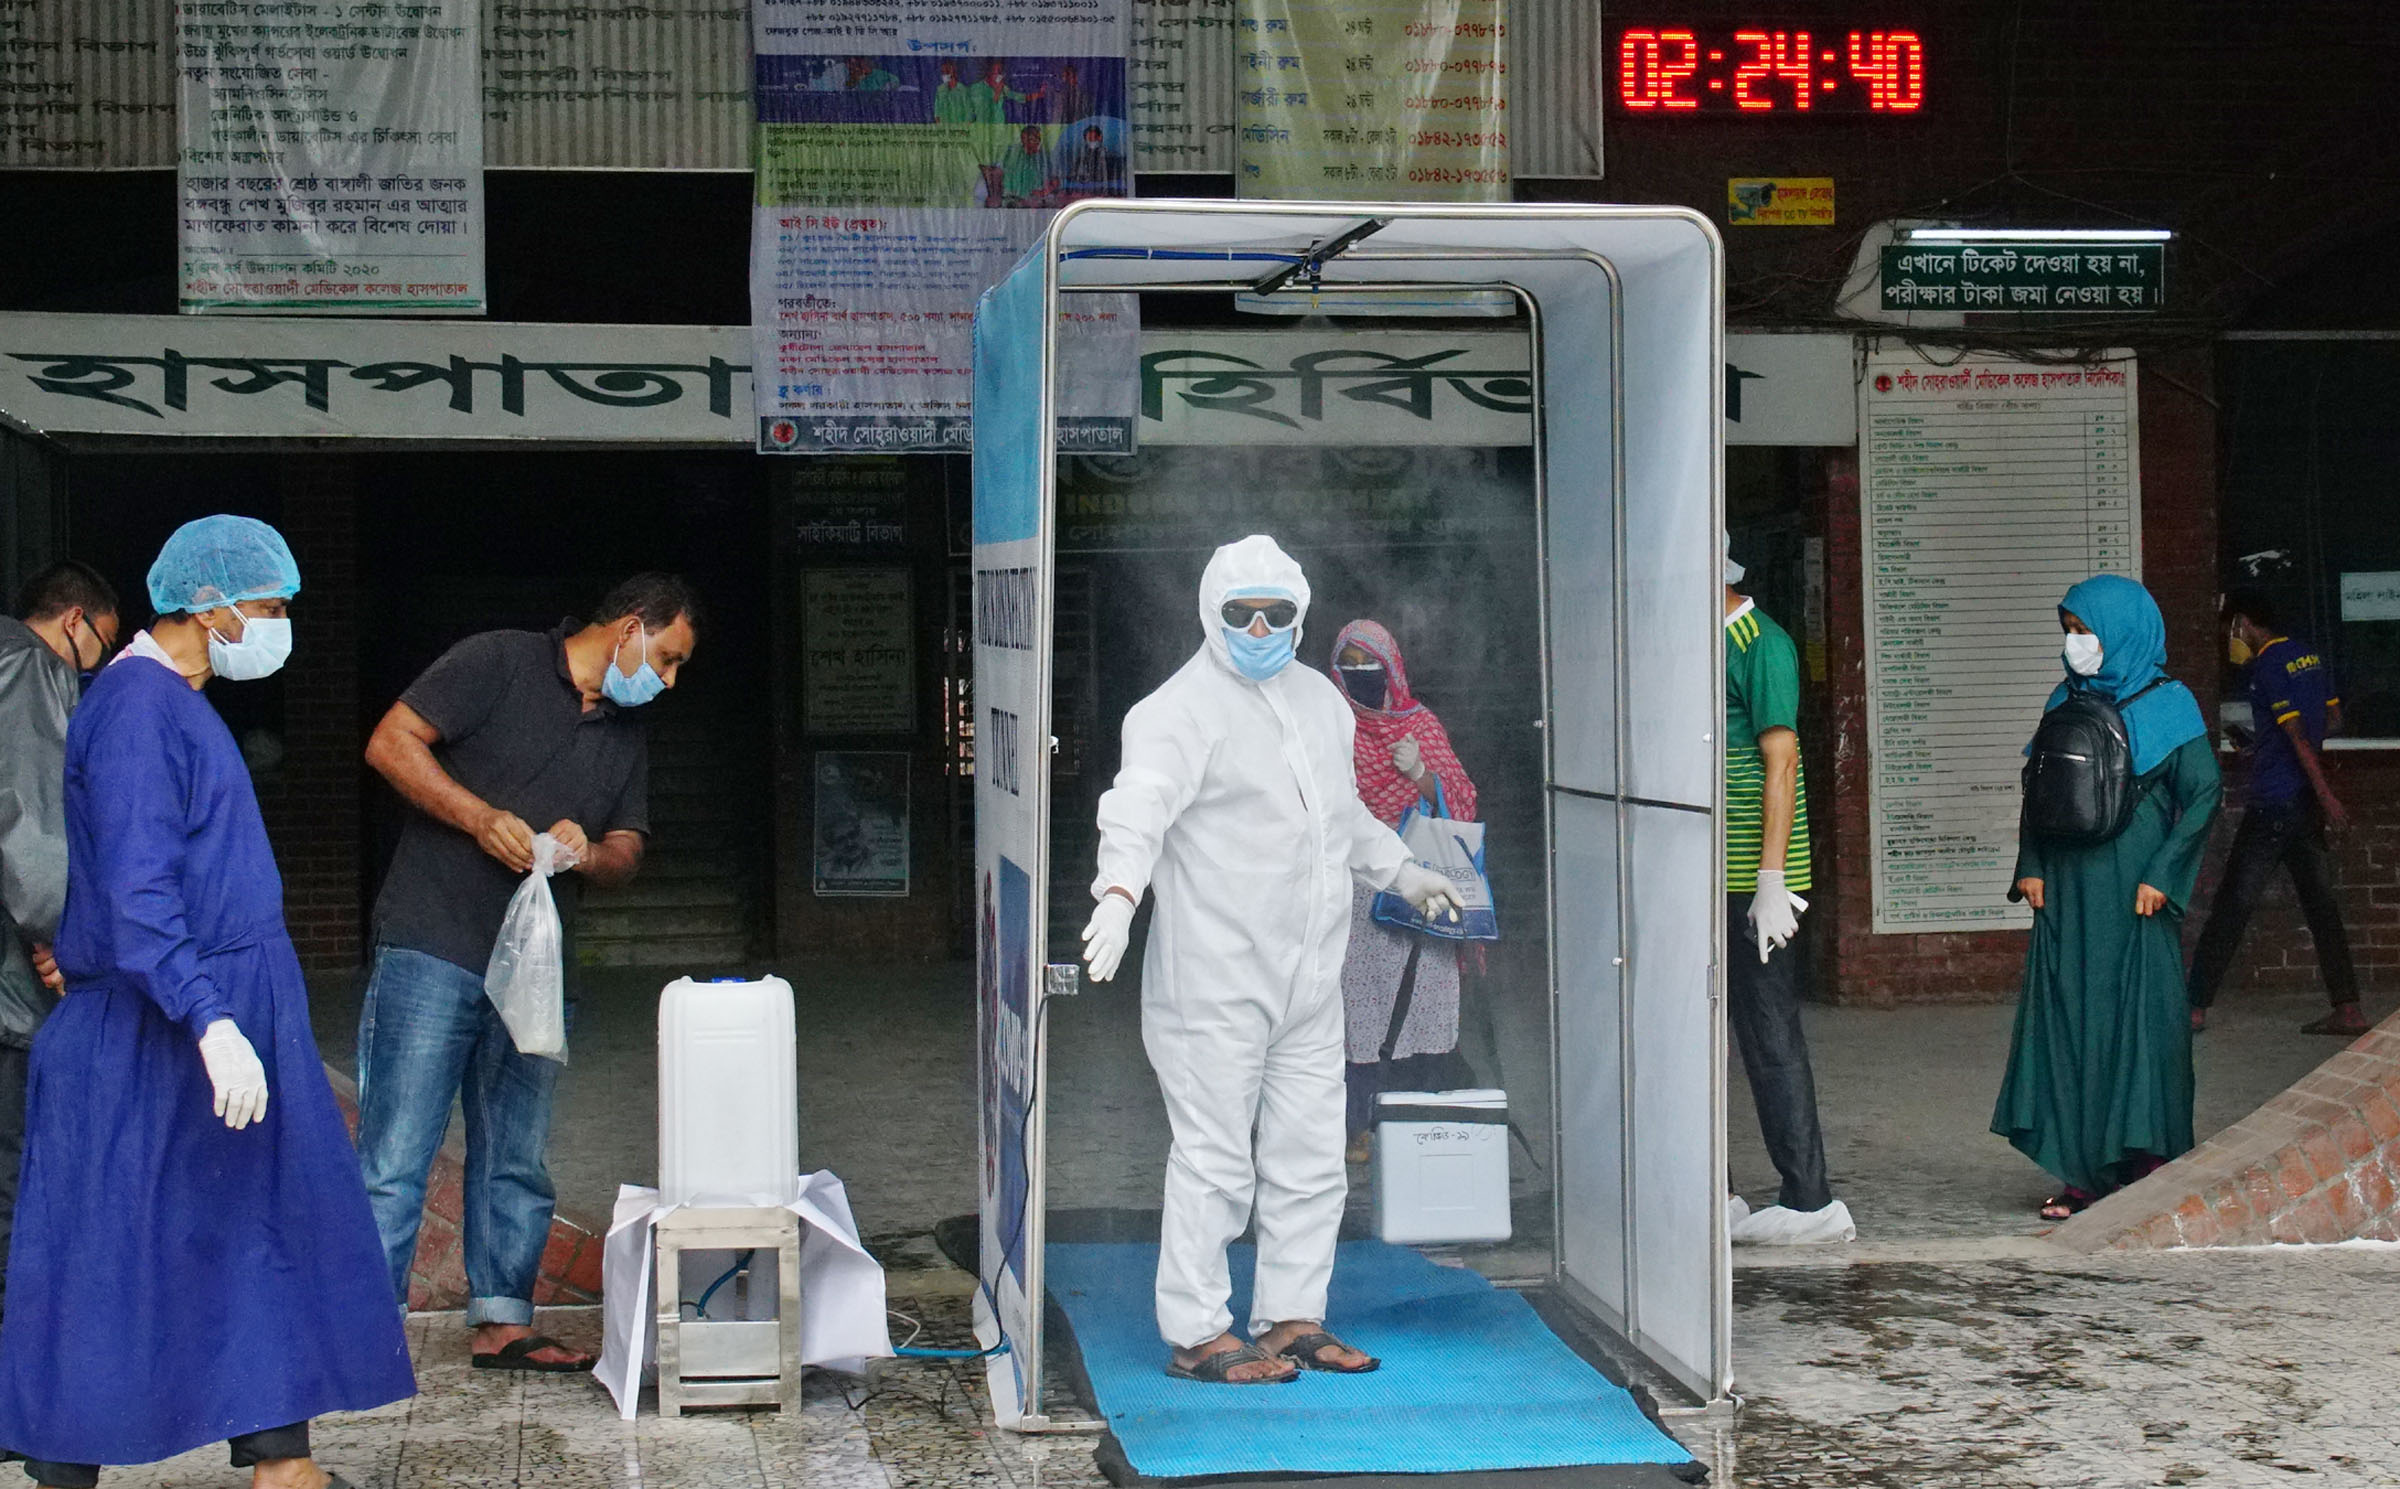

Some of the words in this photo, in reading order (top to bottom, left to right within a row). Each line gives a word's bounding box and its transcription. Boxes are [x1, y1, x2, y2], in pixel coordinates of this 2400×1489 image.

[1621, 30, 1922, 110] 02:24:40
[185, 176, 229, 192] হাজার
[236, 177, 282, 193] বছরের
[378, 174, 423, 191] জাতির
[430, 176, 466, 191] জনক
[239, 198, 269, 213] শেখ
[275, 194, 326, 214] মুজিবুর
[333, 198, 380, 213] রহমান
[387, 199, 410, 213] এর
[272, 219, 318, 234] কামনা
[325, 219, 357, 234] করে
[364, 217, 410, 234] বিশেষ
[417, 219, 456, 235] দোয়া
[343, 264, 379, 276] ২০২০
[1898, 255, 1955, 275] এখানে
[1962, 249, 2017, 273] টিকেট
[2023, 255, 2078, 276] দেওয়া
[2086, 255, 2111, 275] হয়
[2118, 255, 2145, 277] না,
[1885, 279, 1955, 305] পরীক্ষার
[1961, 280, 2003, 304] টাকা
[2010, 285, 2047, 304] জমা
[2055, 285, 2110, 305] নেওয়া
[2117, 285, 2143, 305] হয়
[3, 347, 753, 419] হাসপাতা
[813, 421, 847, 444] শহীদ
[943, 422, 973, 444] মেডি
[865, 520, 904, 543] বিভাগ
[811, 647, 846, 667] শেখ
